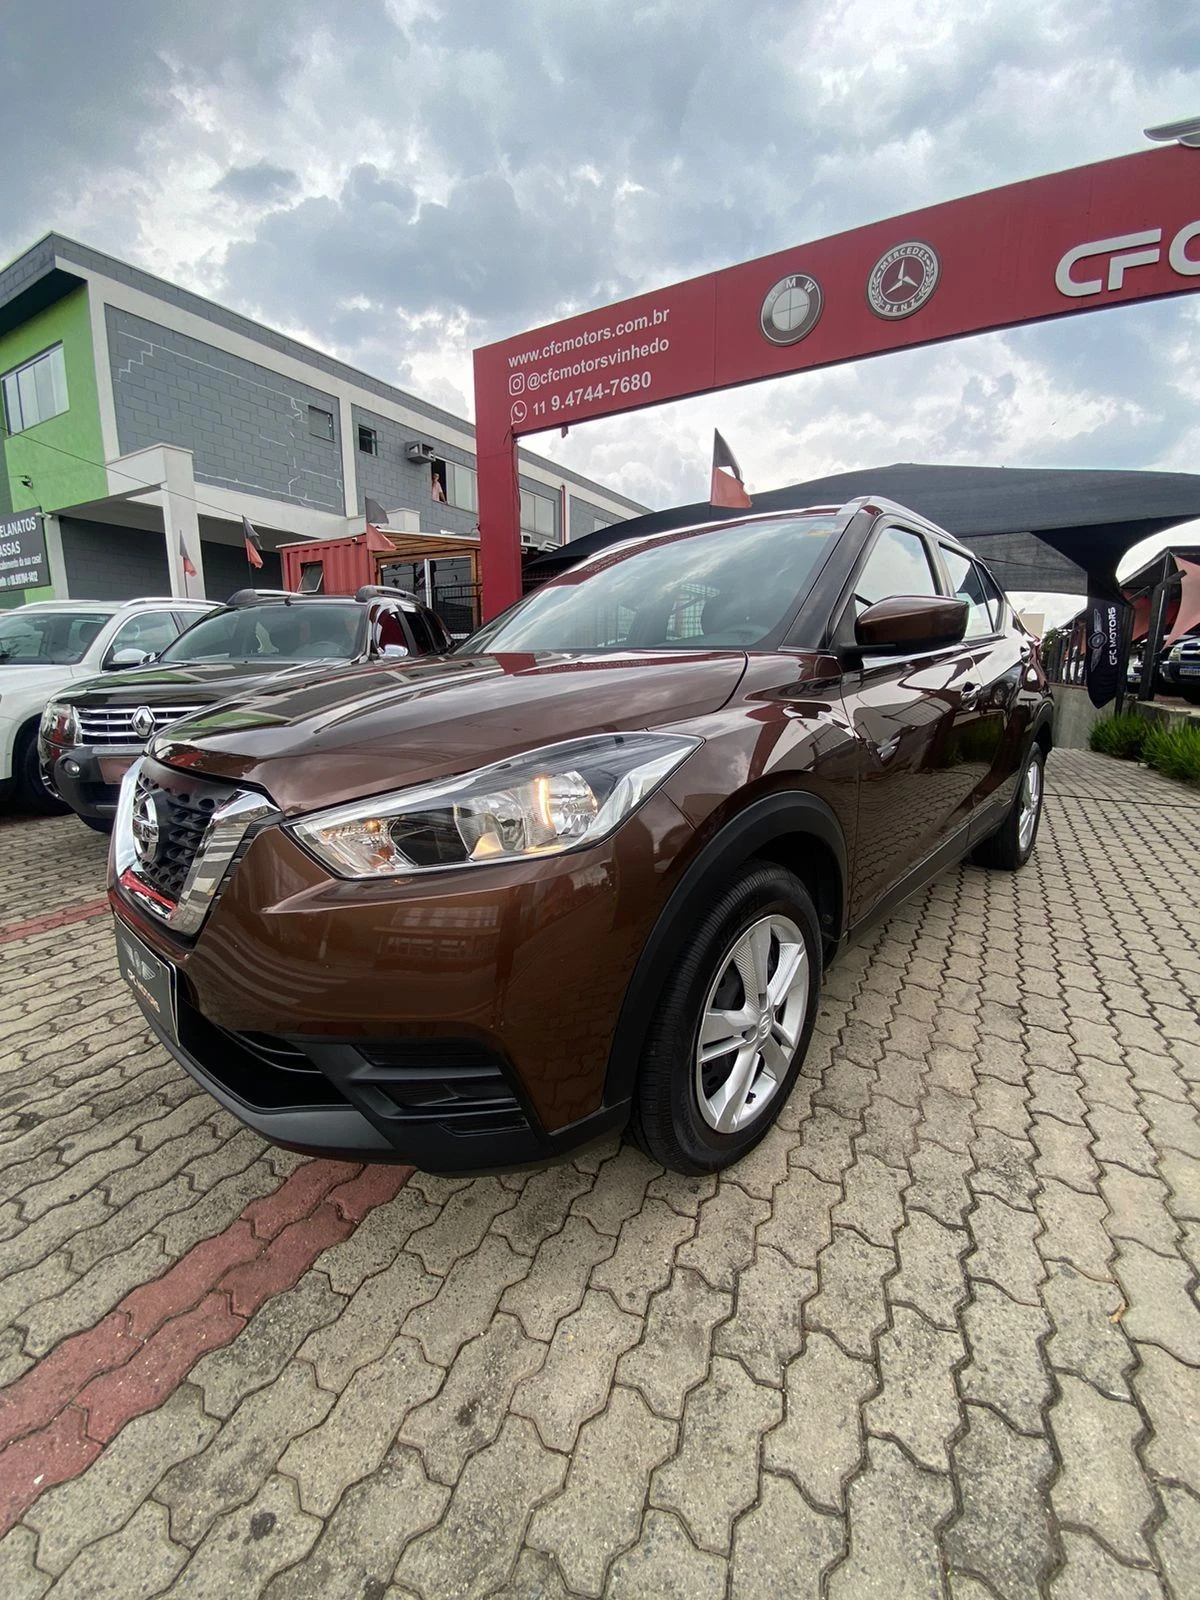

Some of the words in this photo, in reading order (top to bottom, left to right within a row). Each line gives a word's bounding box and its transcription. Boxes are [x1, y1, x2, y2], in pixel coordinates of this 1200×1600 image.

[880, 247, 929, 271] MERCEDES
[884, 298, 918, 313] BENZ
[508, 308, 670, 368] www.cfcmotors.com.br
[527, 338, 669, 390] @cfcmotorsvinhedo
[532, 400, 546, 416] 11
[551, 371, 652, 412] 9.4744-7680
[1108, 606, 1117, 647] MOTORS
[1109, 648, 1118, 666] CFC
